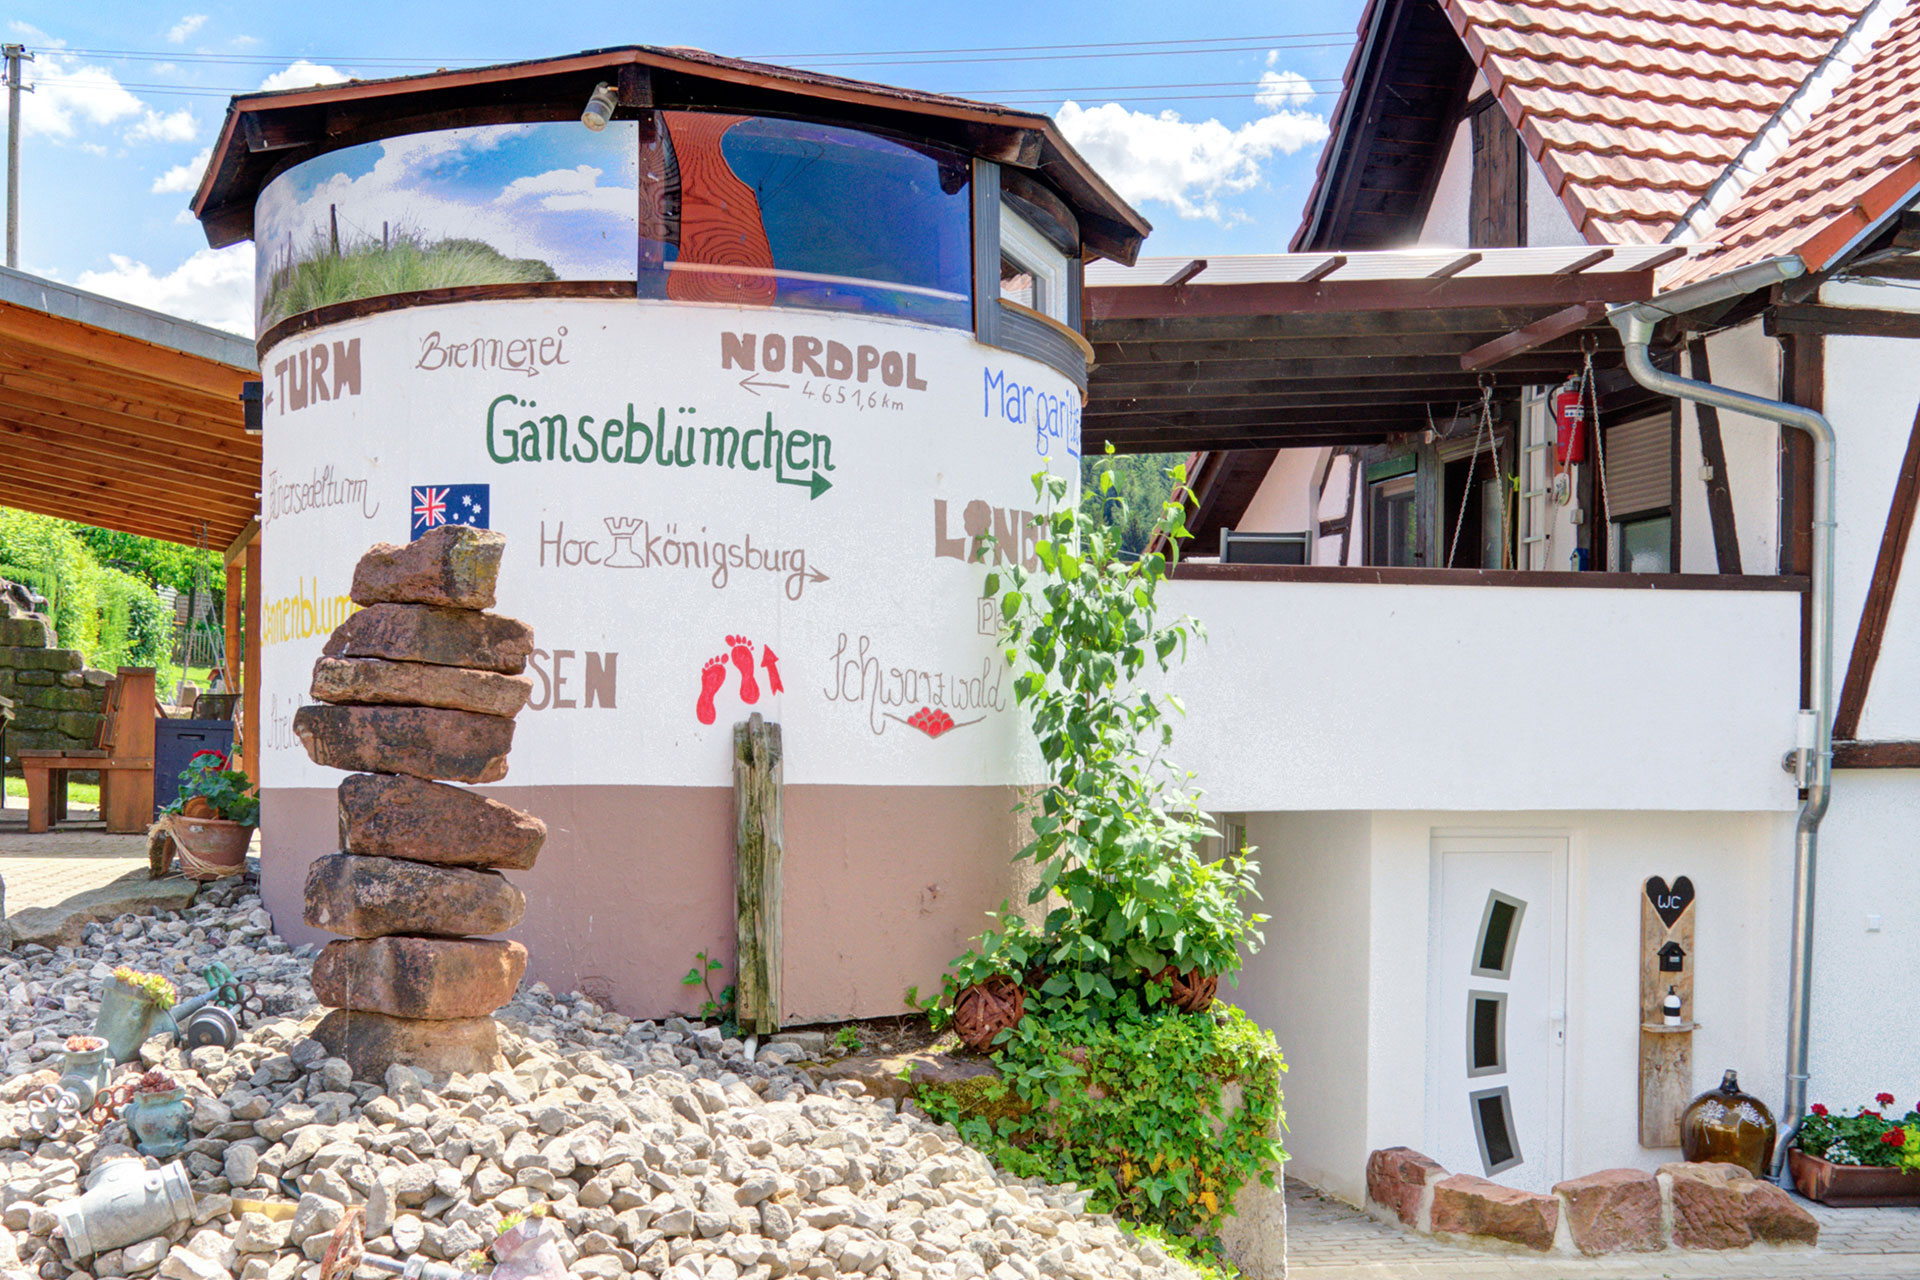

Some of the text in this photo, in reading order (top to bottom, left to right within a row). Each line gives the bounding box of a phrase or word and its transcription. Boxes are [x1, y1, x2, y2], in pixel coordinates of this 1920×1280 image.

[275, 338, 361, 415] TURM
[721, 331, 928, 391] NORDPOL
[882, 393, 904, 411] km
[486, 394, 836, 471] Gänseblümchen
[1657, 894, 1682, 910] WC
